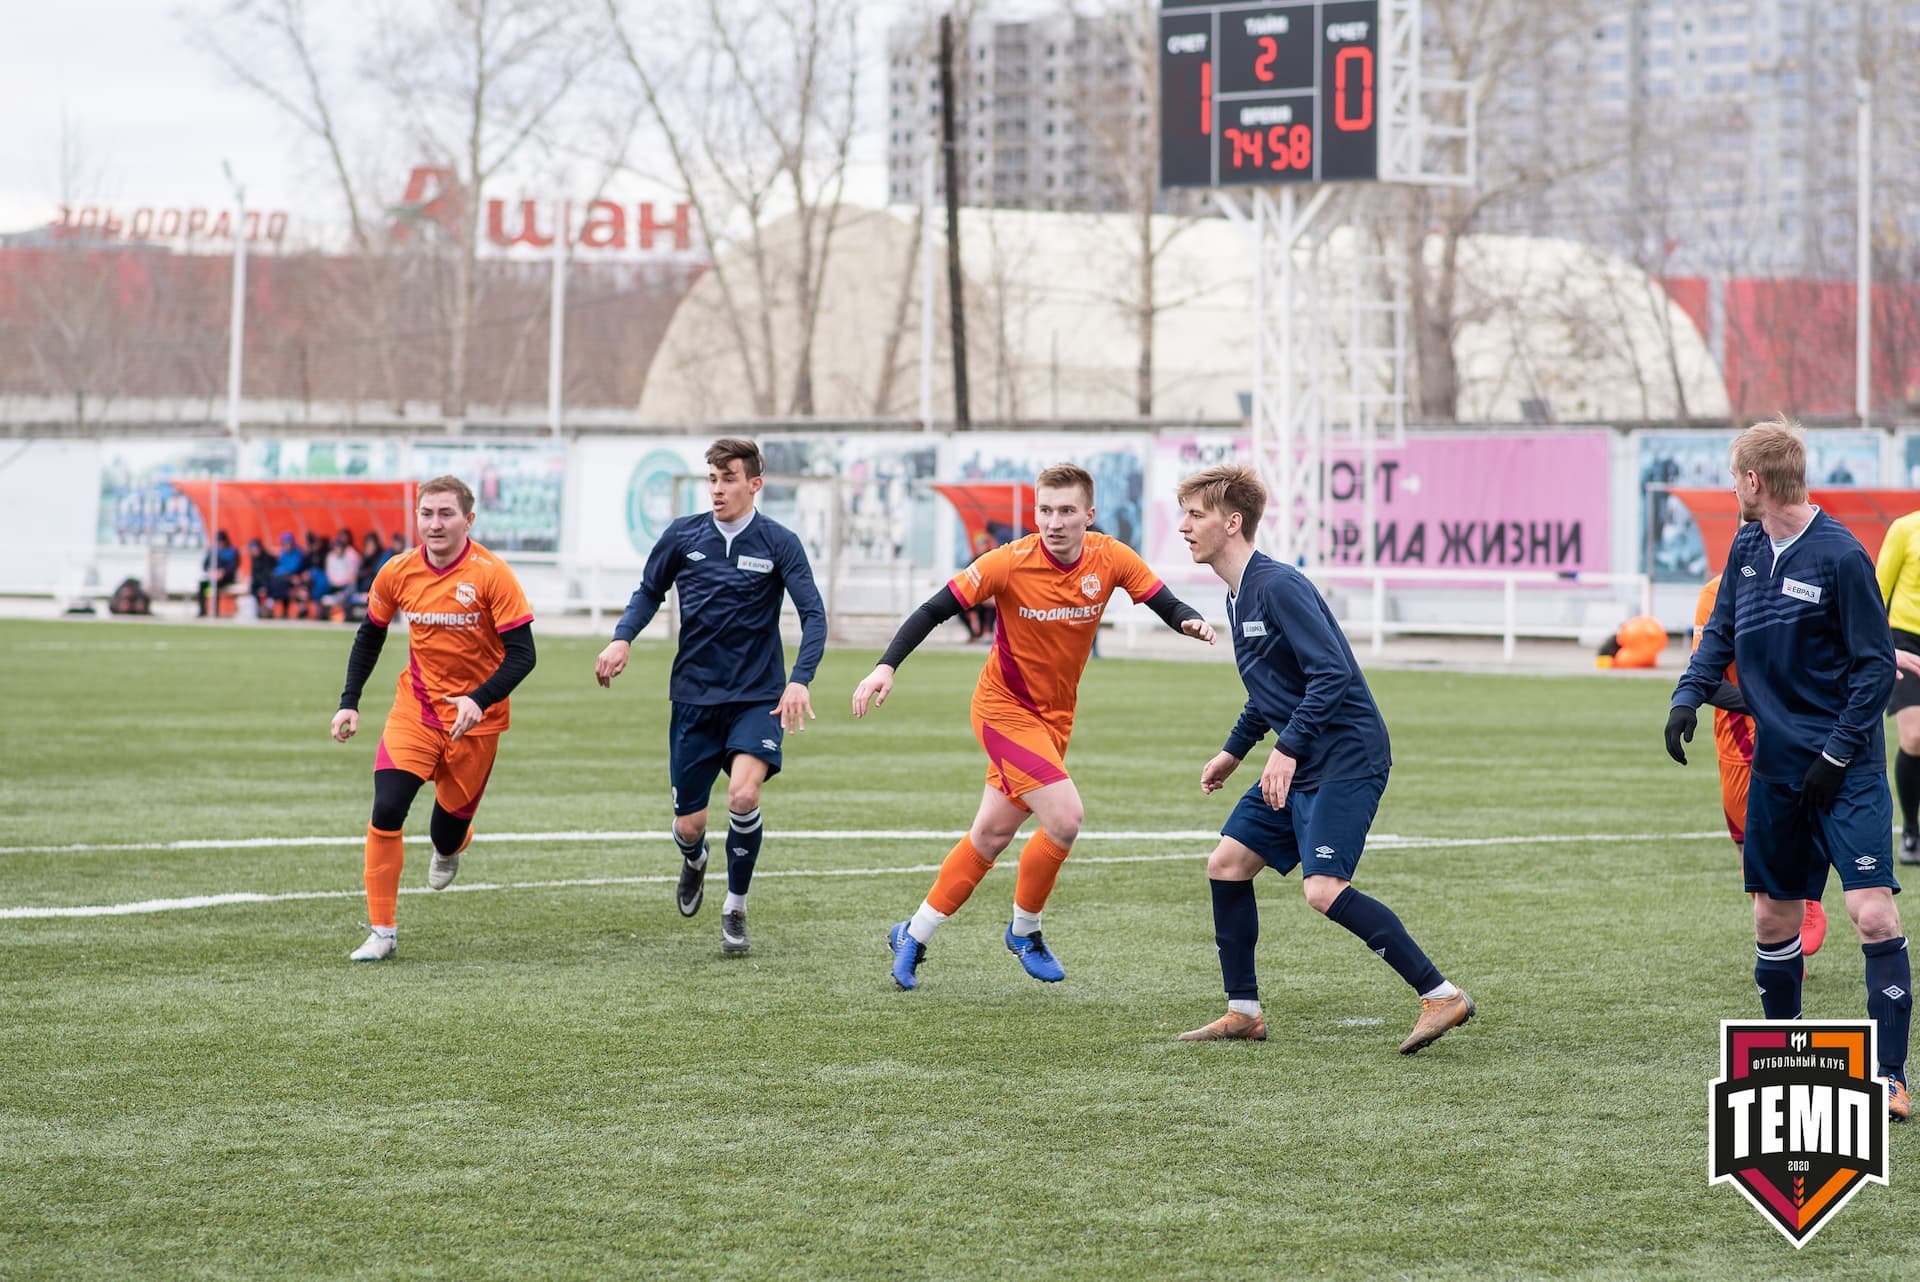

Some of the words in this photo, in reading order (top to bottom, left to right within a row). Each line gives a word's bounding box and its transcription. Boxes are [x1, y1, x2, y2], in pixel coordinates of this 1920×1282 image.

[1255, 36, 1278, 82] 2
[1201, 62, 1211, 135] 1
[1335, 46, 1373, 131] 0
[1438, 520, 1582, 565] ЖИЗНИ
[1018, 602, 1104, 621] ПРОДИНВЕСТ
[1792, 586, 1815, 598] ЕВРАЗ
